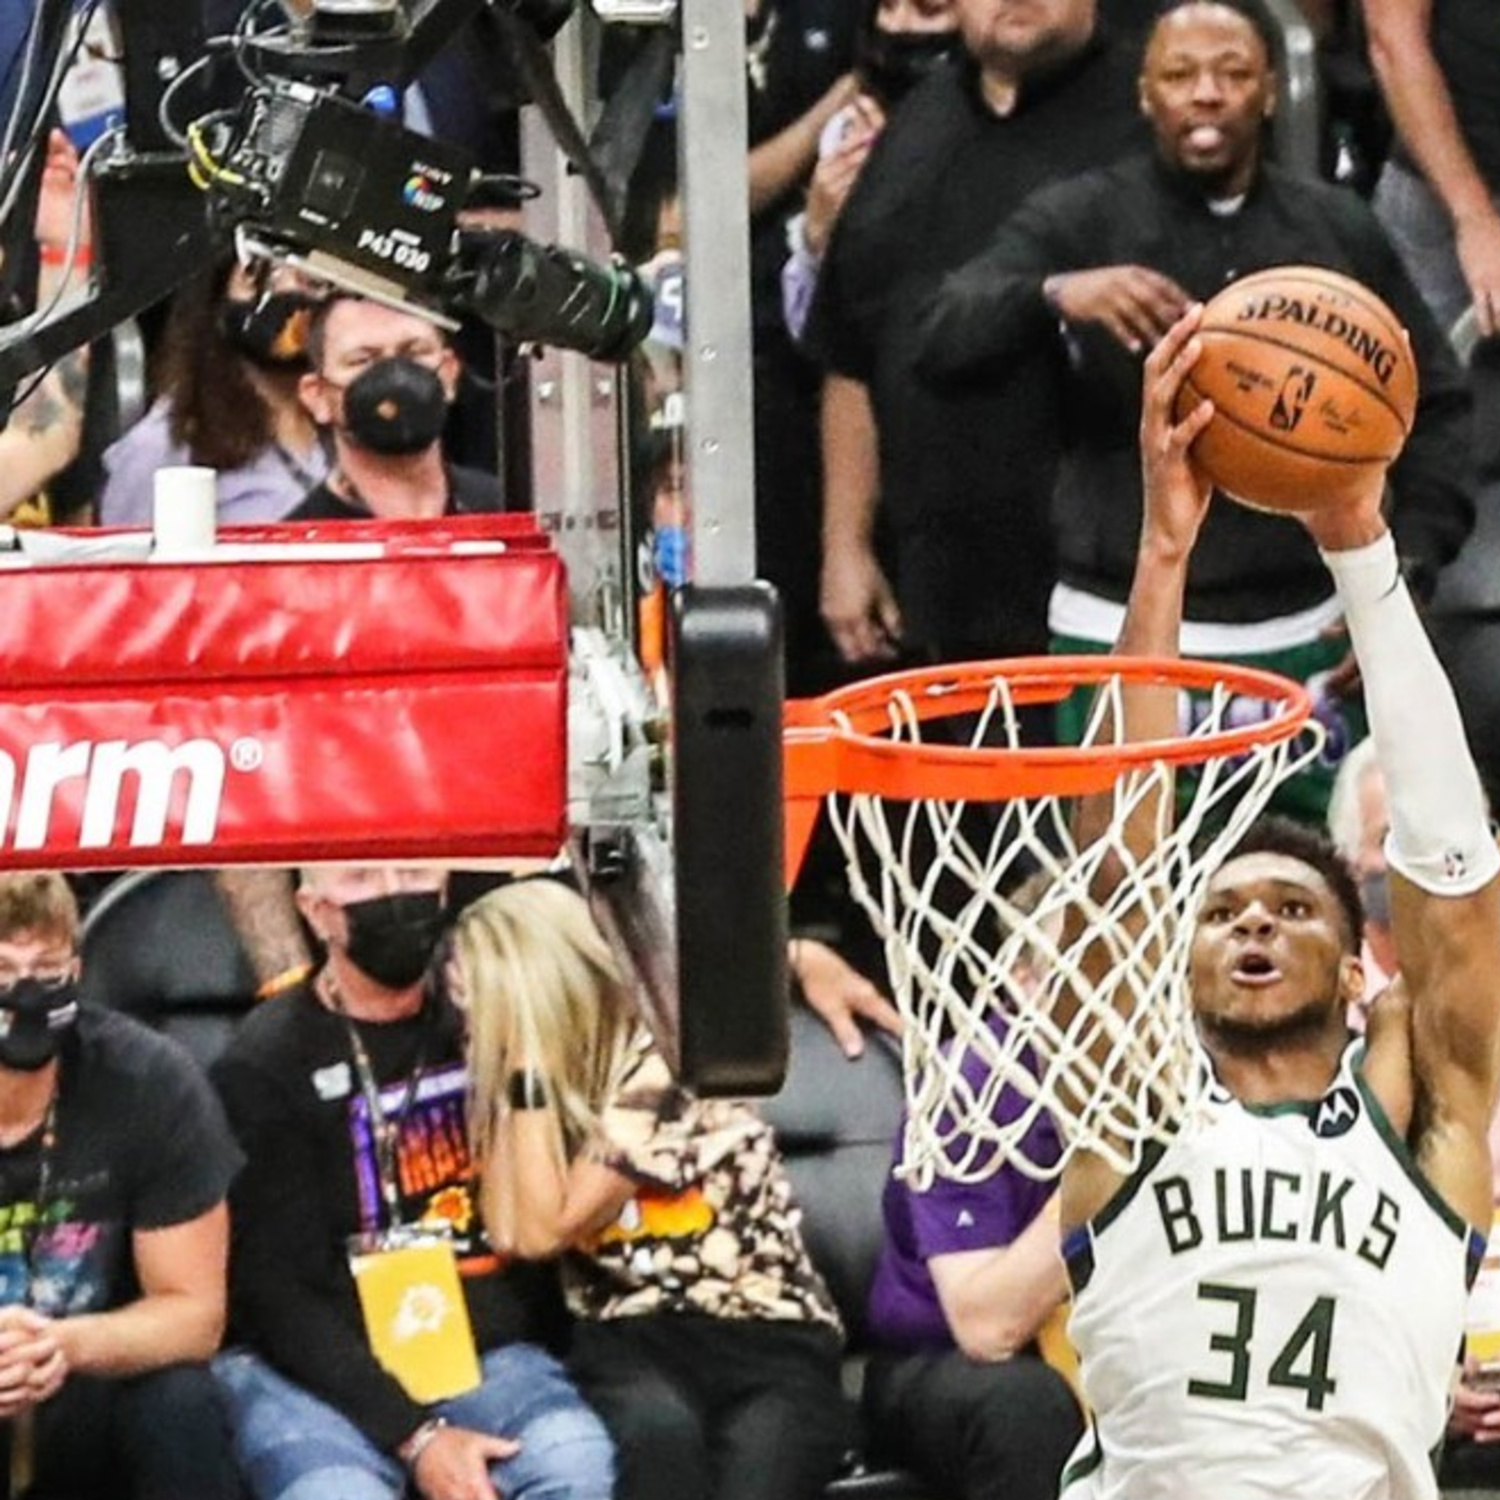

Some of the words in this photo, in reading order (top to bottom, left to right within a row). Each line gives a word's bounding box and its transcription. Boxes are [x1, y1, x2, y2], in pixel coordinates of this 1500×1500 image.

[1237, 295, 1396, 385] SPALDING
[1154, 1169, 1400, 1271] BUCKS
[1187, 1282, 1338, 1411] 34
